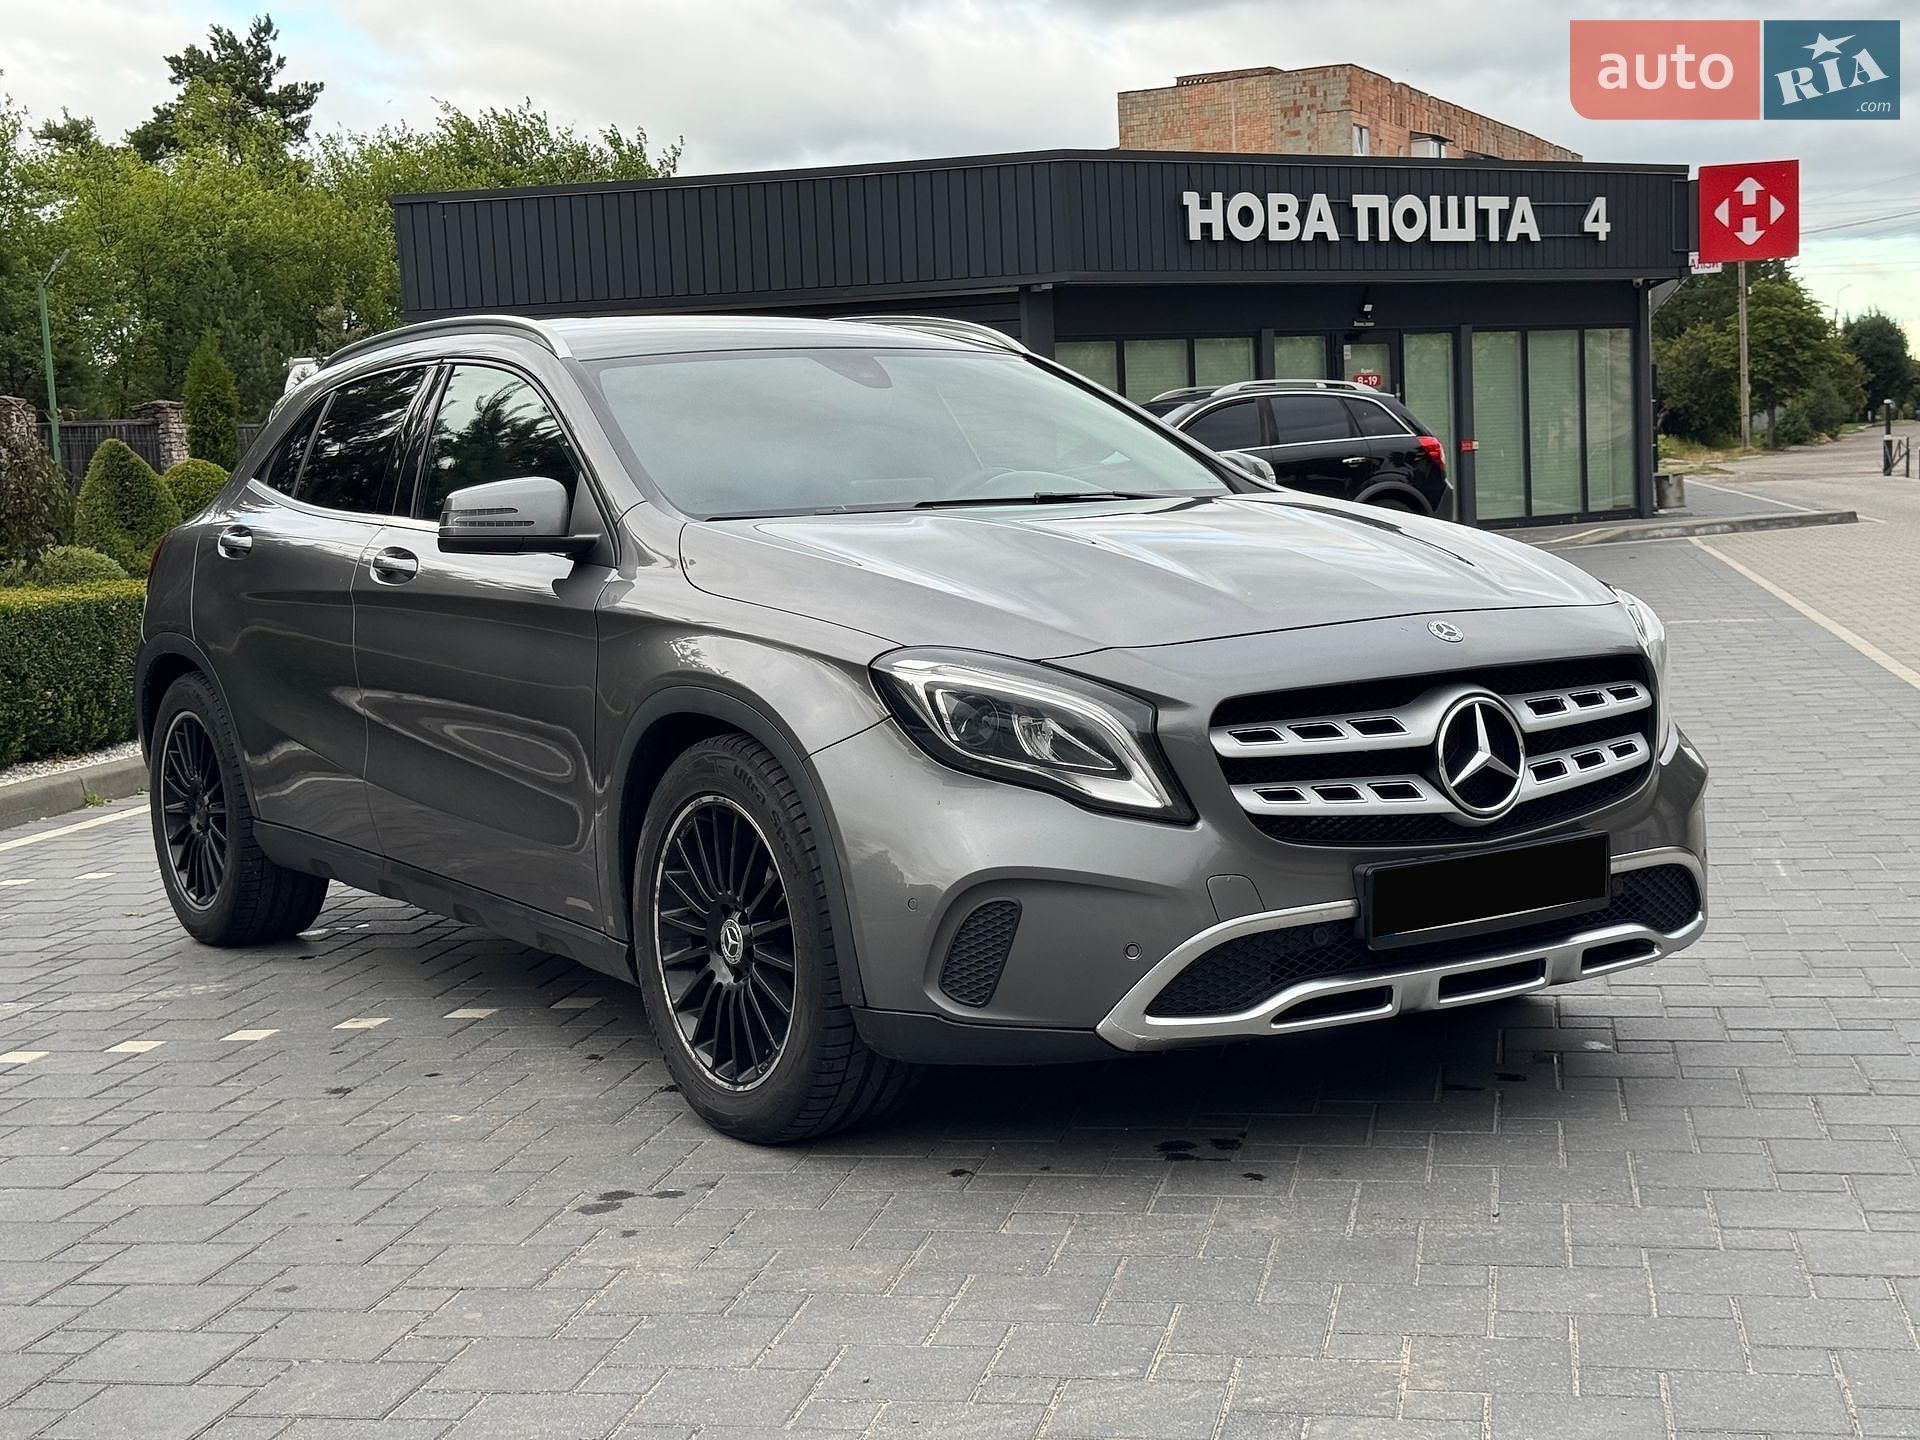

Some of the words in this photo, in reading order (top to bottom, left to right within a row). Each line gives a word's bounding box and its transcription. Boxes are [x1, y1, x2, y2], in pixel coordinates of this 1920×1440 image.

[1183, 191, 1340, 242] НОВА
[1352, 194, 1541, 243] ПОШТА
[1583, 196, 1611, 241] 4
